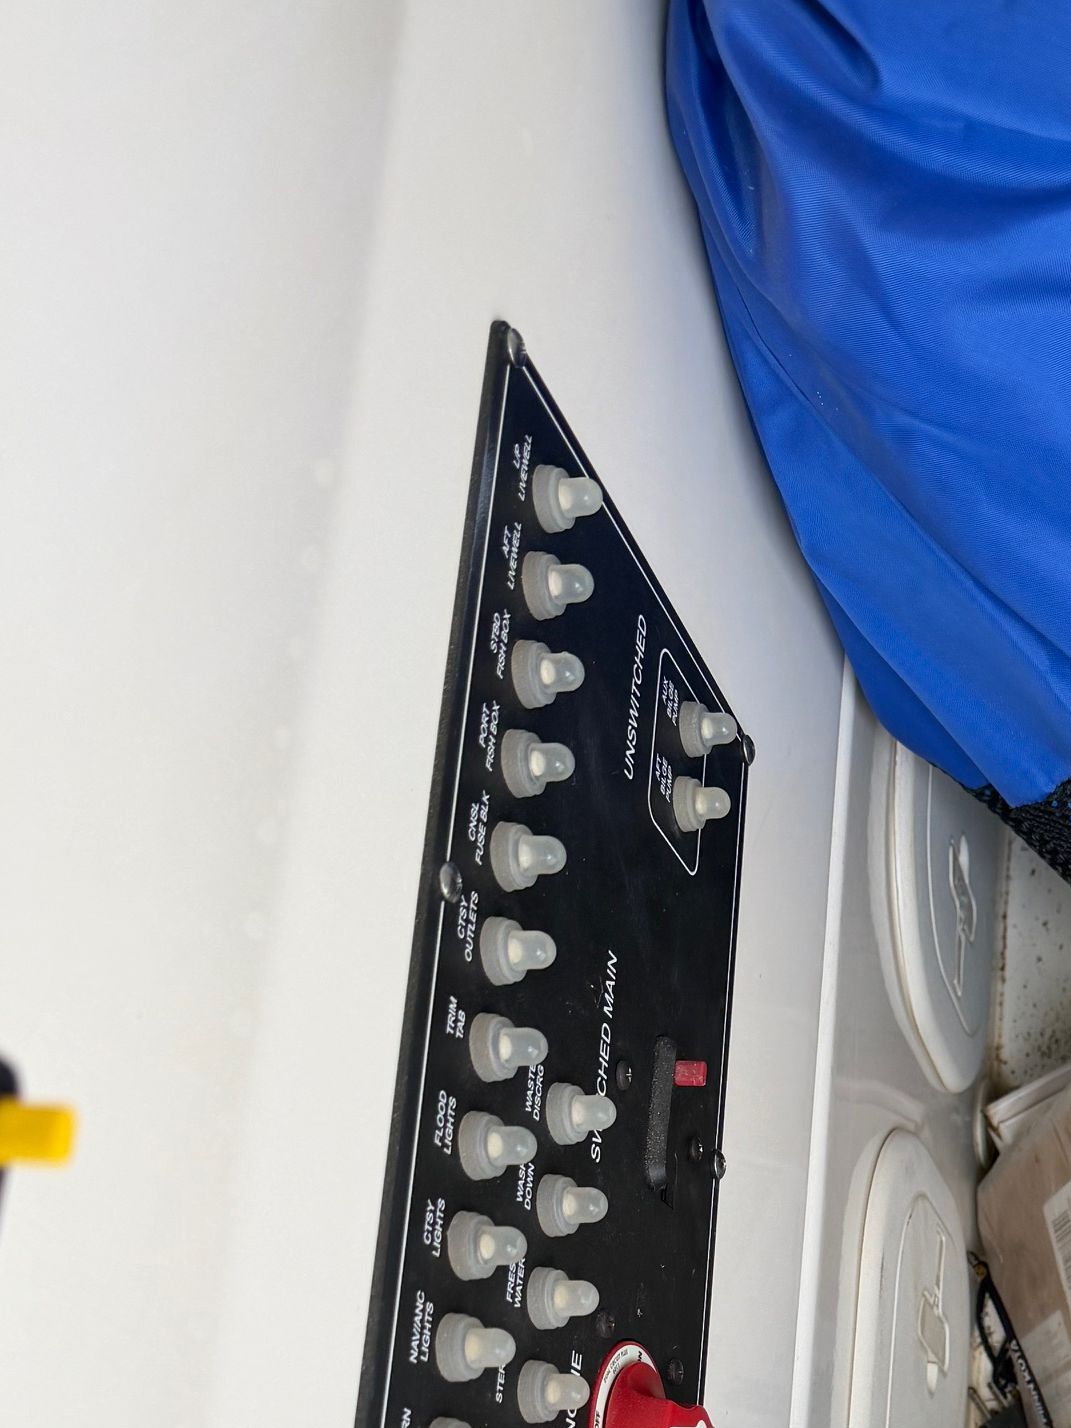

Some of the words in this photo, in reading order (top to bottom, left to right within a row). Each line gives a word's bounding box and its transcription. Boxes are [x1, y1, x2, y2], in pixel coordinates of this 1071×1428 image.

[518, 434, 533, 501] LIVEWELL
[502, 525, 511, 559] AFT
[507, 522, 522, 590] LIVEWELL
[490, 612, 500, 653] STBD
[500, 608, 512, 641] BOX
[496, 642, 507, 679] FISH
[624, 614, 647, 780] UNSWITCHED
[661, 676, 669, 705] AUX
[666, 680, 675, 719] BILGE
[672, 689, 680, 727] PUMP
[479, 703, 488, 747] PORT
[490, 700, 500, 732] BOX
[486, 733, 497, 772] FISH
[660, 756, 669, 796] BILGE
[665, 765, 674, 803] PUMP
[467, 802, 480, 841] CNSL
[480, 790, 491, 821] BLK
[475, 824, 487, 865] FUSE
[457, 895, 468, 939] CTSY
[464, 890, 479, 962] OUTLETS
[446, 996, 458, 1035] TRIM
[455, 1010, 466, 1038] TAB
[591, 1022, 613, 1163] SWCHED
[603, 950, 618, 1018] MAIN
[533, 1064, 545, 1122] DISCRG
[434, 1090, 447, 1147] FLOOD
[443, 1096, 457, 1155] LIGHTS
[524, 1163, 535, 1211] DOWN
[423, 1199, 435, 1246] CTSY
[432, 1197, 446, 1258] LIGHTS
[506, 1261, 517, 1303] FRES
[513, 1257, 526, 1308] WATER
[408, 1290, 426, 1364] NAV/ANC
[420, 1302, 435, 1363] LIGHTS
